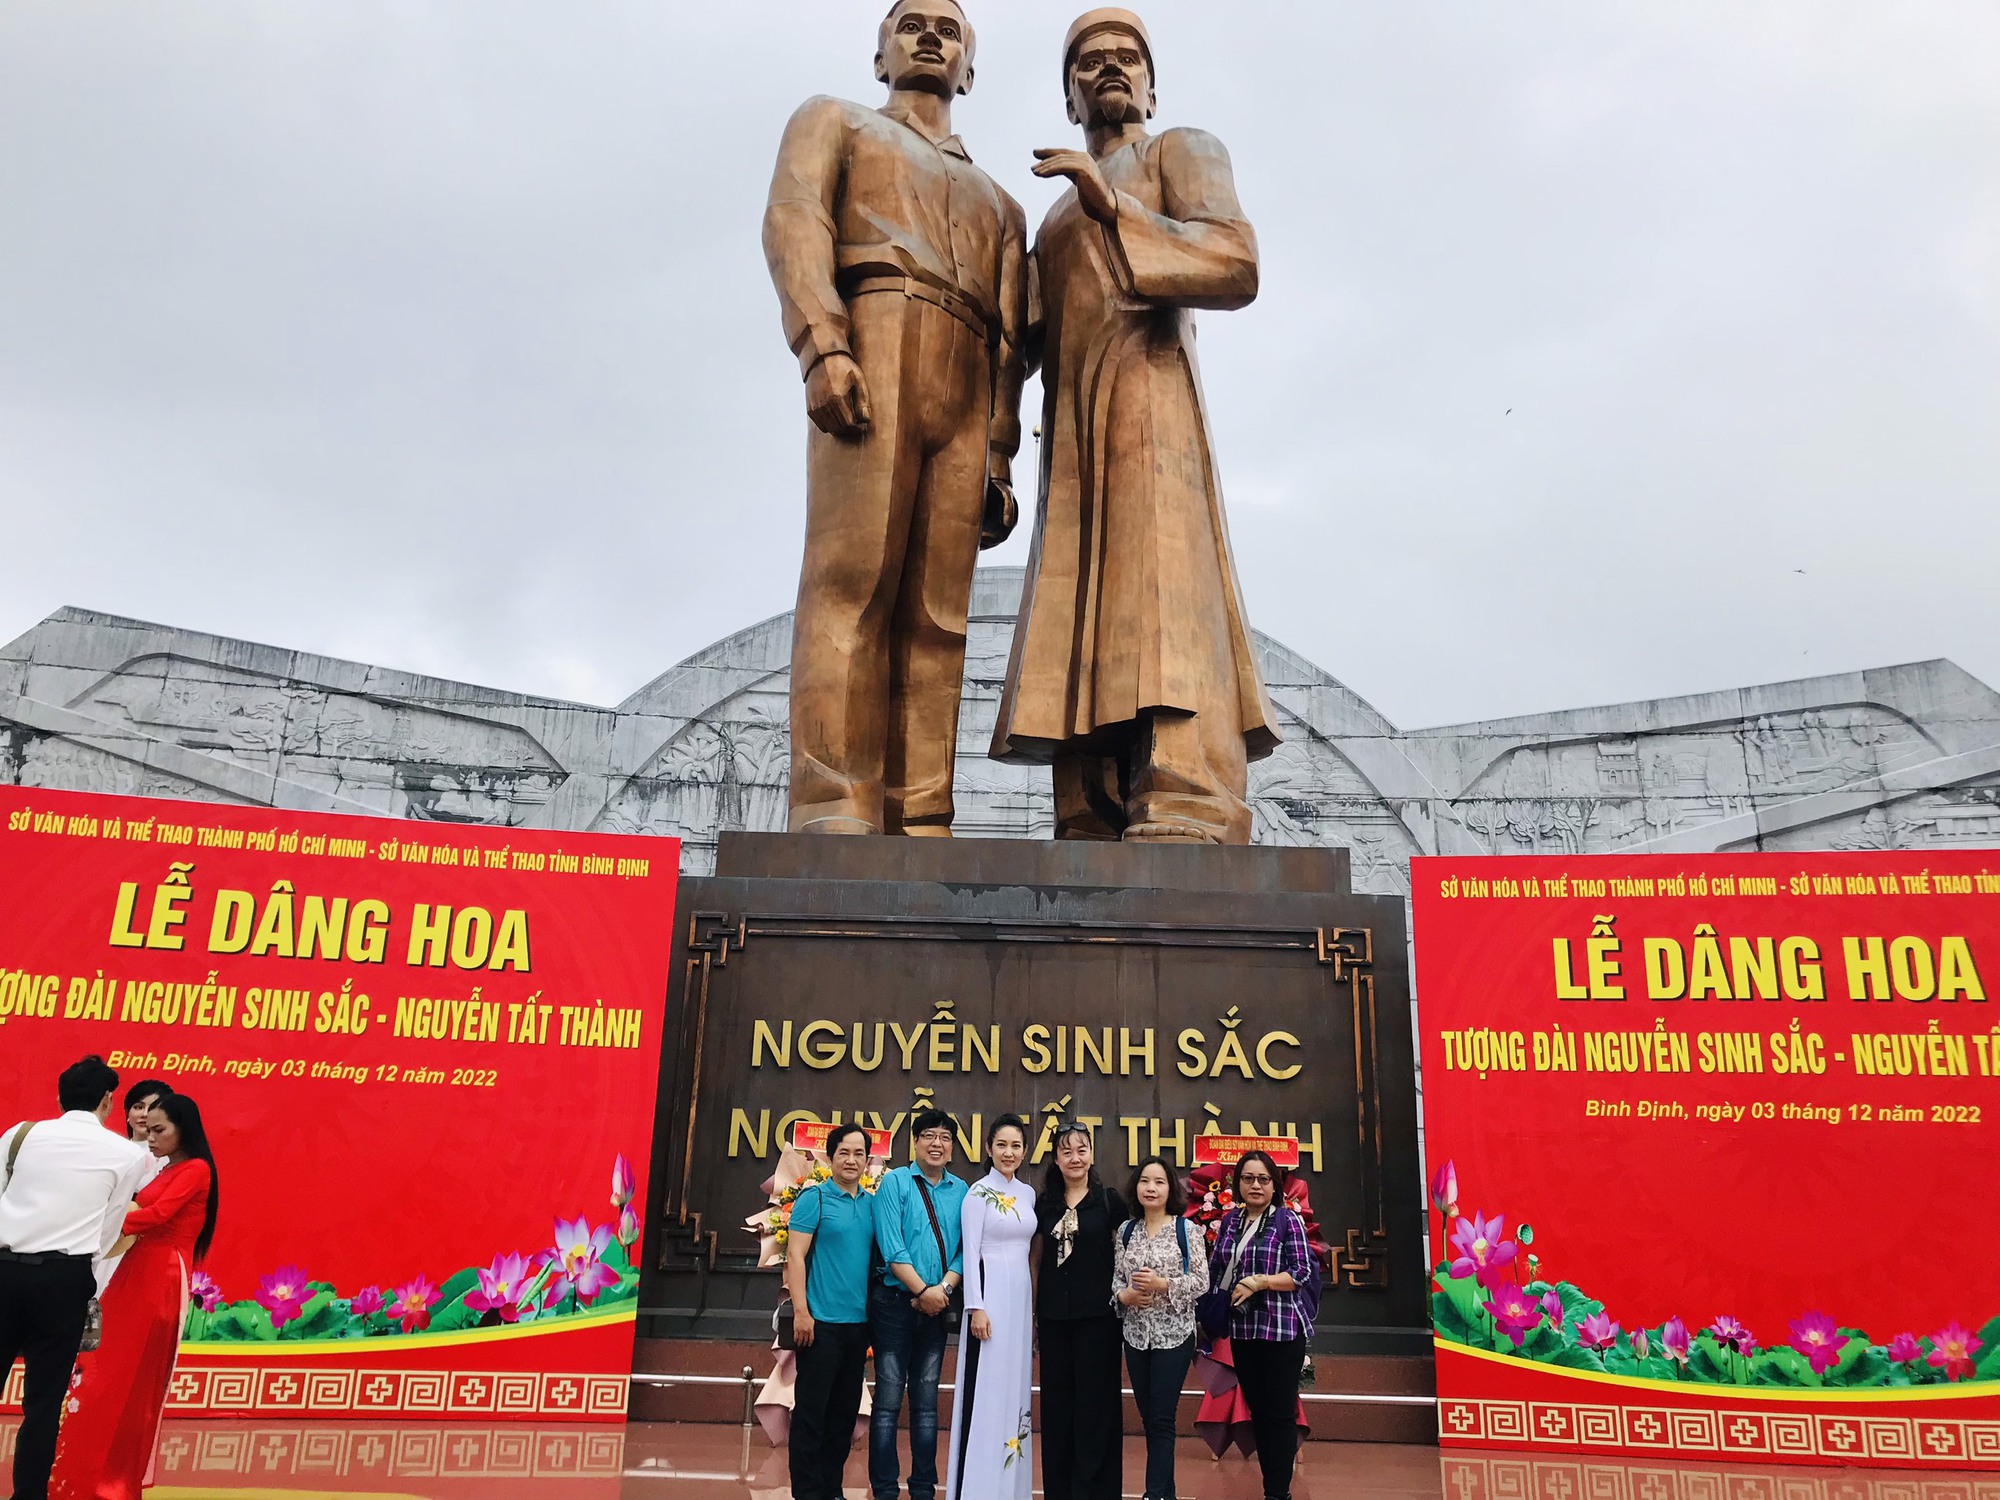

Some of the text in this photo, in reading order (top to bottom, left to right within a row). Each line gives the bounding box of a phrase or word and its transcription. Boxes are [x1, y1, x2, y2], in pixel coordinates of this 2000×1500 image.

[8, 807, 32, 833] SỞ
[33, 812, 65, 835] VĂN
[66, 814, 98, 838] HÓA
[102, 816, 121, 840] VÀ
[125, 816, 155, 842] THỂ
[156, 824, 194, 845] THAO
[196, 825, 245, 849] THÀNH
[245, 827, 276, 852] PHỐ
[278, 830, 298, 854] HỒ
[300, 833, 327, 856] CHÍ
[327, 837, 366, 859] MINH
[377, 838, 399, 862] SỞ
[401, 842, 430, 865] VĂN
[430, 844, 459, 867] HÓA
[462, 847, 480, 868] VÀ
[484, 845, 511, 869] THỂ
[511, 851, 545, 872] THAO
[548, 848, 580, 874] TỈNH
[582, 853, 615, 876] BÌNH
[616, 857, 650, 879] ĐỊNH
[109, 861, 532, 973] LỄ DÂNG HOA
[1440, 874, 1459, 899] SỞ
[1461, 876, 1489, 898] VĂN
[1491, 877, 1520, 898] HÓA
[1522, 875, 1541, 898] VÀ
[1542, 872, 1568, 898] THỂ
[1570, 878, 1606, 898] THAO
[1608, 875, 1655, 898] THÀNH
[1657, 872, 1685, 897] PHỐ
[1688, 872, 1708, 897] HỒ
[1711, 875, 1736, 897] CHÍ
[1737, 877, 1777, 896] MINH
[1790, 871, 1810, 896] SỞ
[1810, 874, 1843, 896] VĂN
[1845, 873, 1877, 895] HÓA
[1878, 872, 1900, 895] VÀ
[1901, 868, 1931, 895] THỂ
[1932, 875, 1972, 895] THAO
[1552, 914, 1987, 1002] LỄ DÂNG HOA
[64, 969, 118, 1021] ĐÀI
[120, 971, 238, 1028] NGUYỄN
[241, 986, 311, 1033] SINH
[314, 979, 369, 1036] SẮC
[393, 987, 501, 1043] NGUYỄN
[507, 991, 554, 1045] TẤT
[559, 996, 642, 1050] THÀNH
[751, 1001, 1303, 1080] NGUYỄN SINH SẮC
[107, 1050, 498, 1087] Bình Định, ngày 03 tháng 12 năm 2022
[1440, 1026, 1527, 1080] TƯỢNG
[1532, 1024, 1578, 1072] ĐÀI
[1583, 1017, 1691, 1074] NGUYỄN
[1697, 1031, 1764, 1074] SINH
[1769, 1017, 1827, 1075] SẮC
[1851, 1018, 1970, 1077] NGUYỄN
[1018, 1093, 1103, 1165] ẤT
[1585, 1098, 1981, 1125] Bình Định, ngày 03 tháng 12 năm 2022
